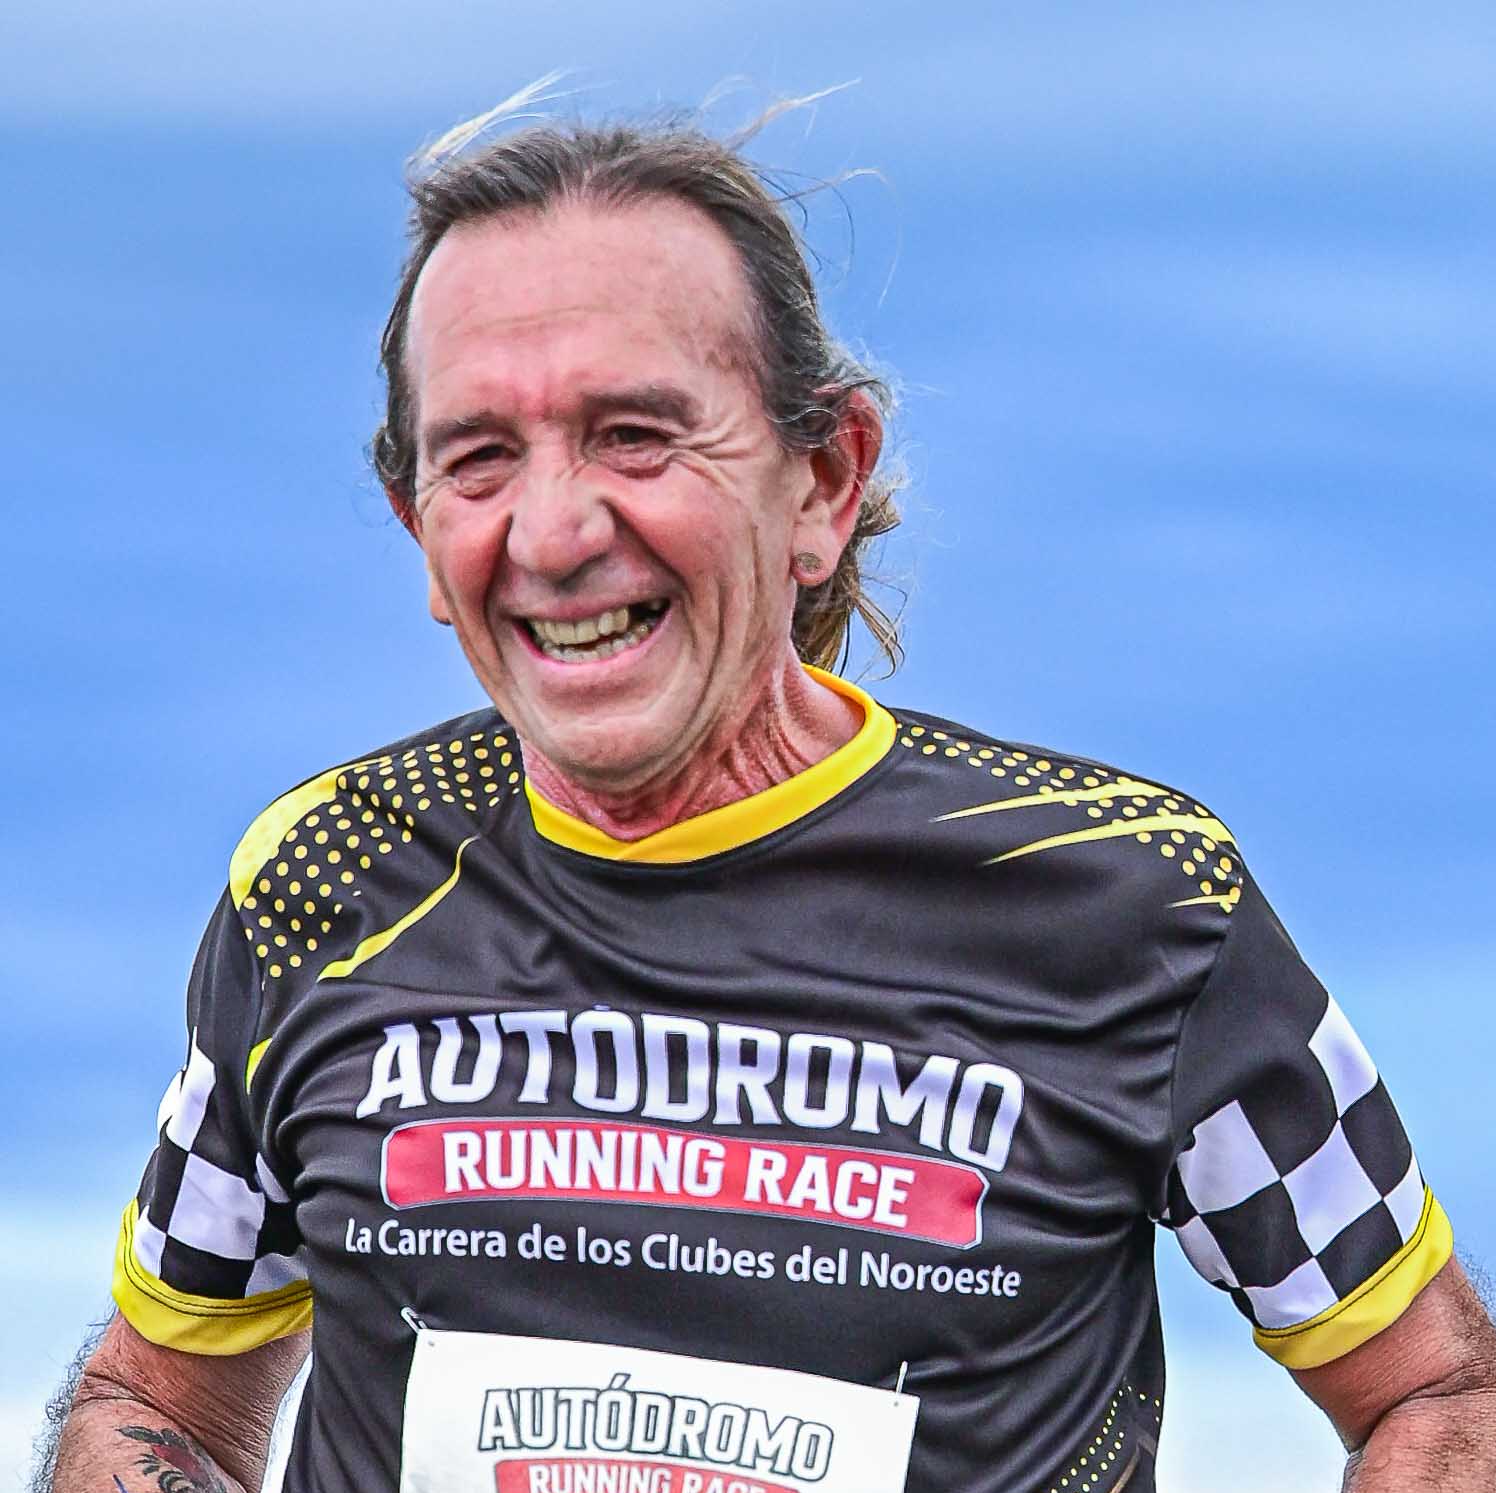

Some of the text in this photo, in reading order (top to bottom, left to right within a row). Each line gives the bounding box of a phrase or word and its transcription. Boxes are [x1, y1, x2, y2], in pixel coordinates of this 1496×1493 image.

[441, 1129, 917, 1228] RUNNING RACE
[345, 1218, 1023, 1298] La Carrera de los Clubes del Noroeste
[477, 1372, 836, 1483] AUTÓDROMO
